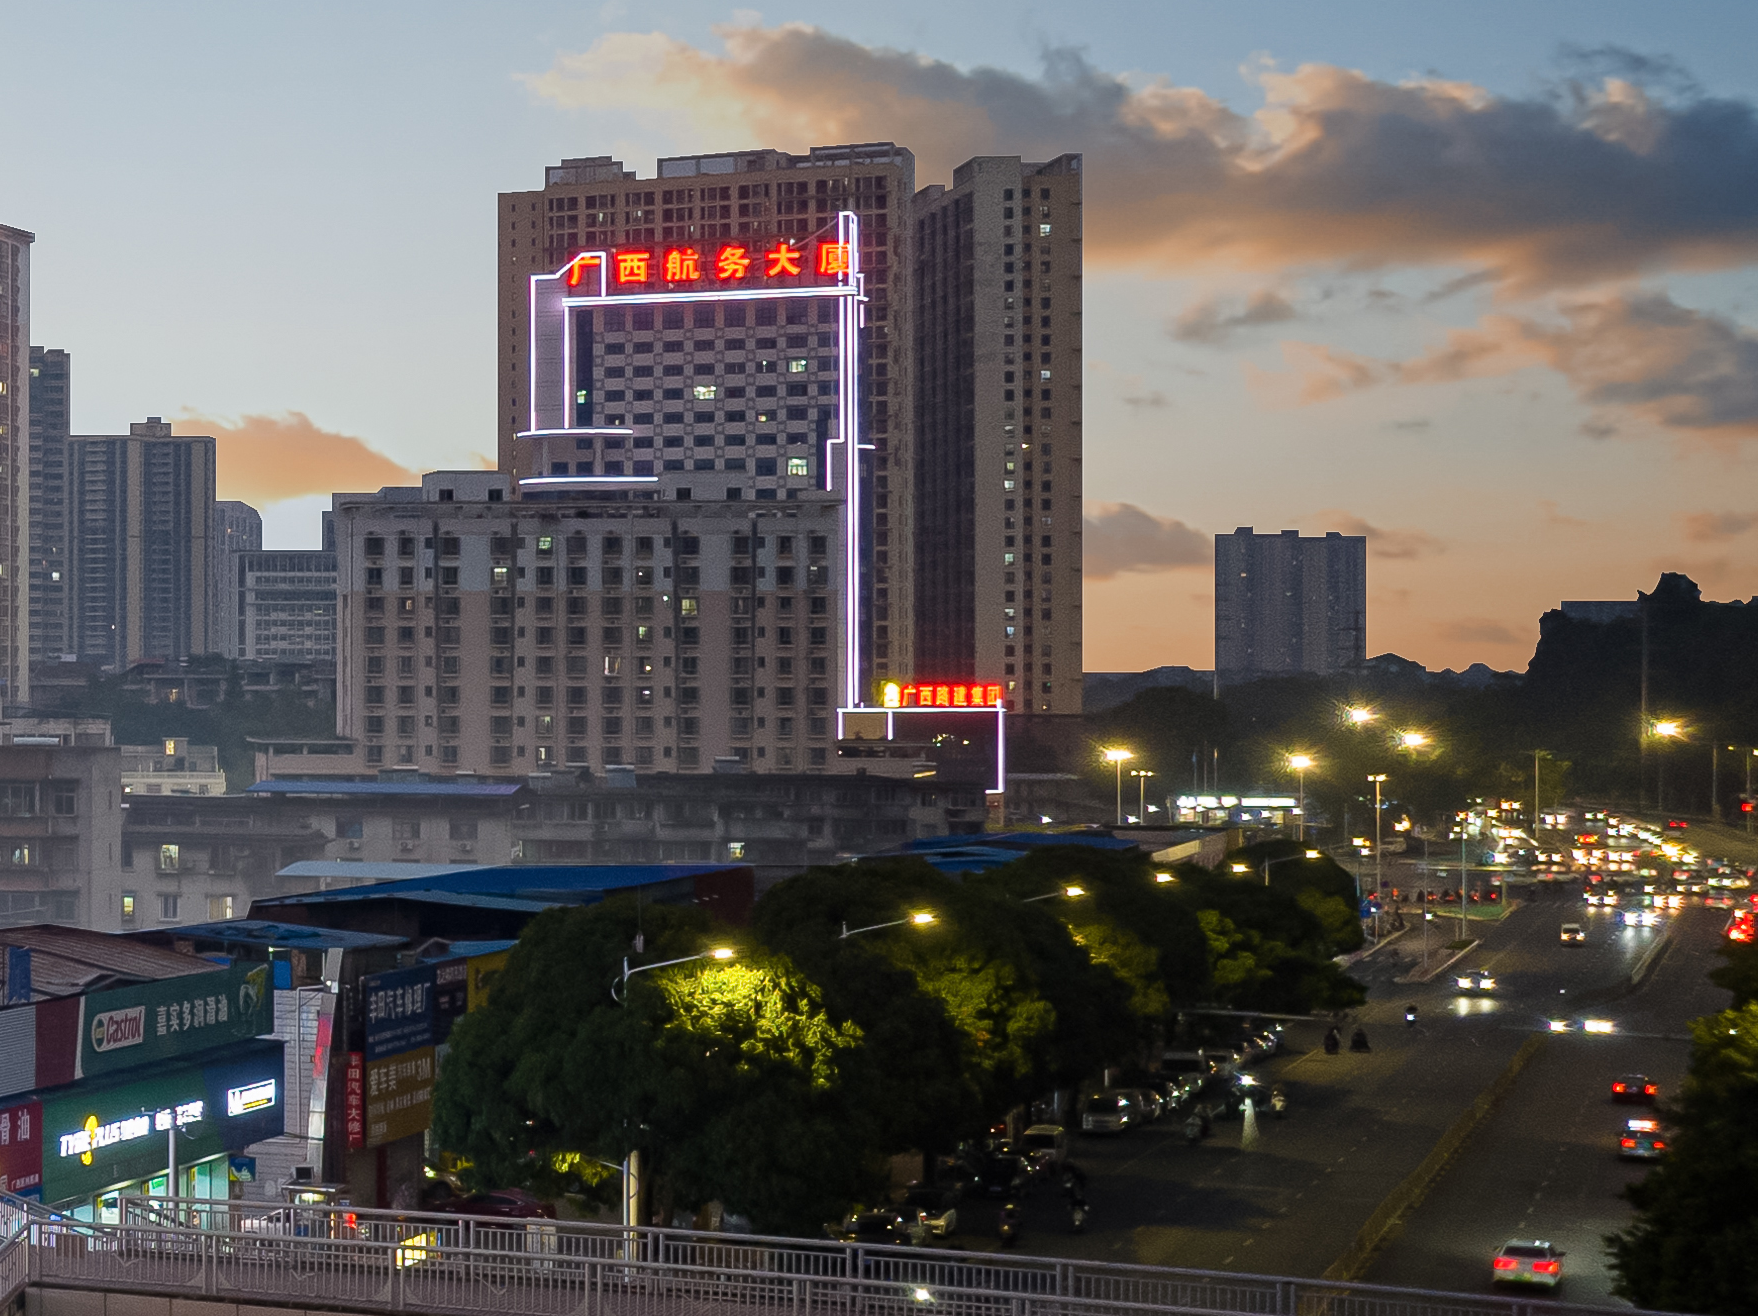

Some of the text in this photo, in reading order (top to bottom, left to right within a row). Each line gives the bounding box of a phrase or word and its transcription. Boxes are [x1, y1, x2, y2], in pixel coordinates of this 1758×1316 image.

[568, 242, 851, 286] 广西航务大厦
[106, 1009, 143, 1045] Castrol
[156, 994, 228, 1036] 嘉实多润滑油
[348, 1053, 363, 1147] 丰田汽车大修厂
